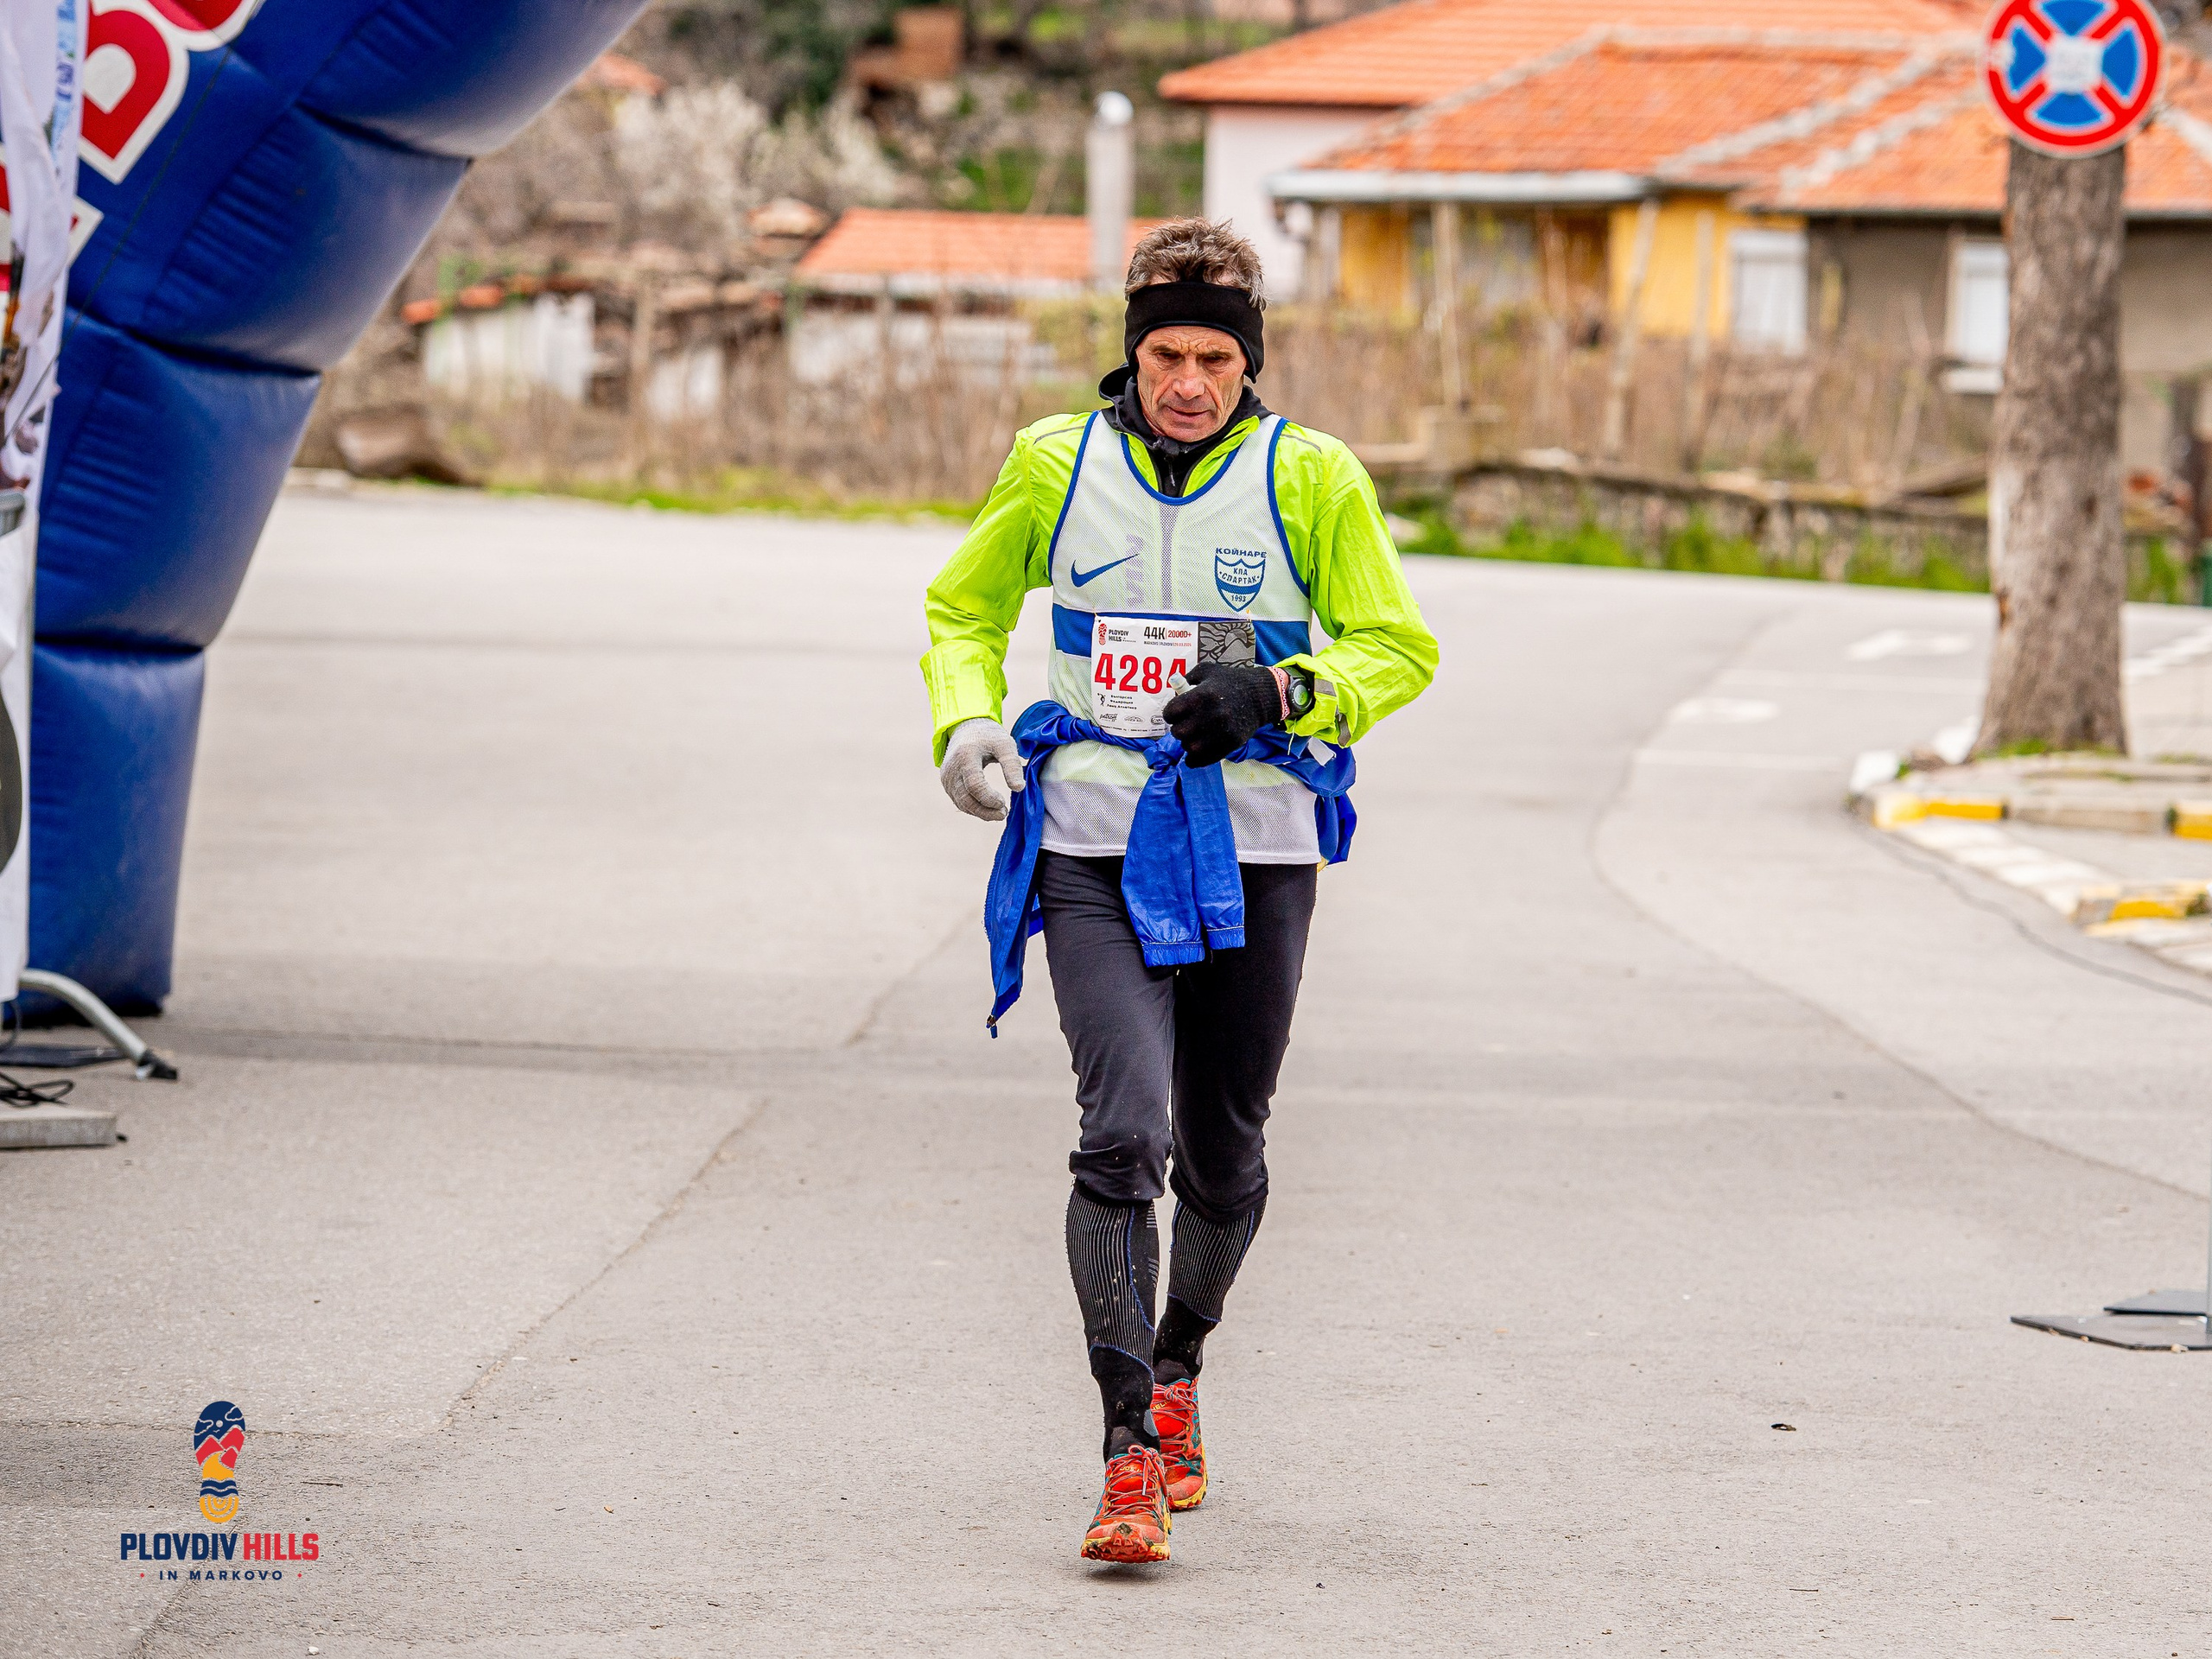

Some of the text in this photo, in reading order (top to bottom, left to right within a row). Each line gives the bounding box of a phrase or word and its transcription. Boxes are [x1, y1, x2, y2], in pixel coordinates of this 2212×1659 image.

[1216, 547, 1267, 558] КОЙНАРЕ
[1143, 626, 1166, 640] 44K
[1095, 653, 1186, 694] 4284
